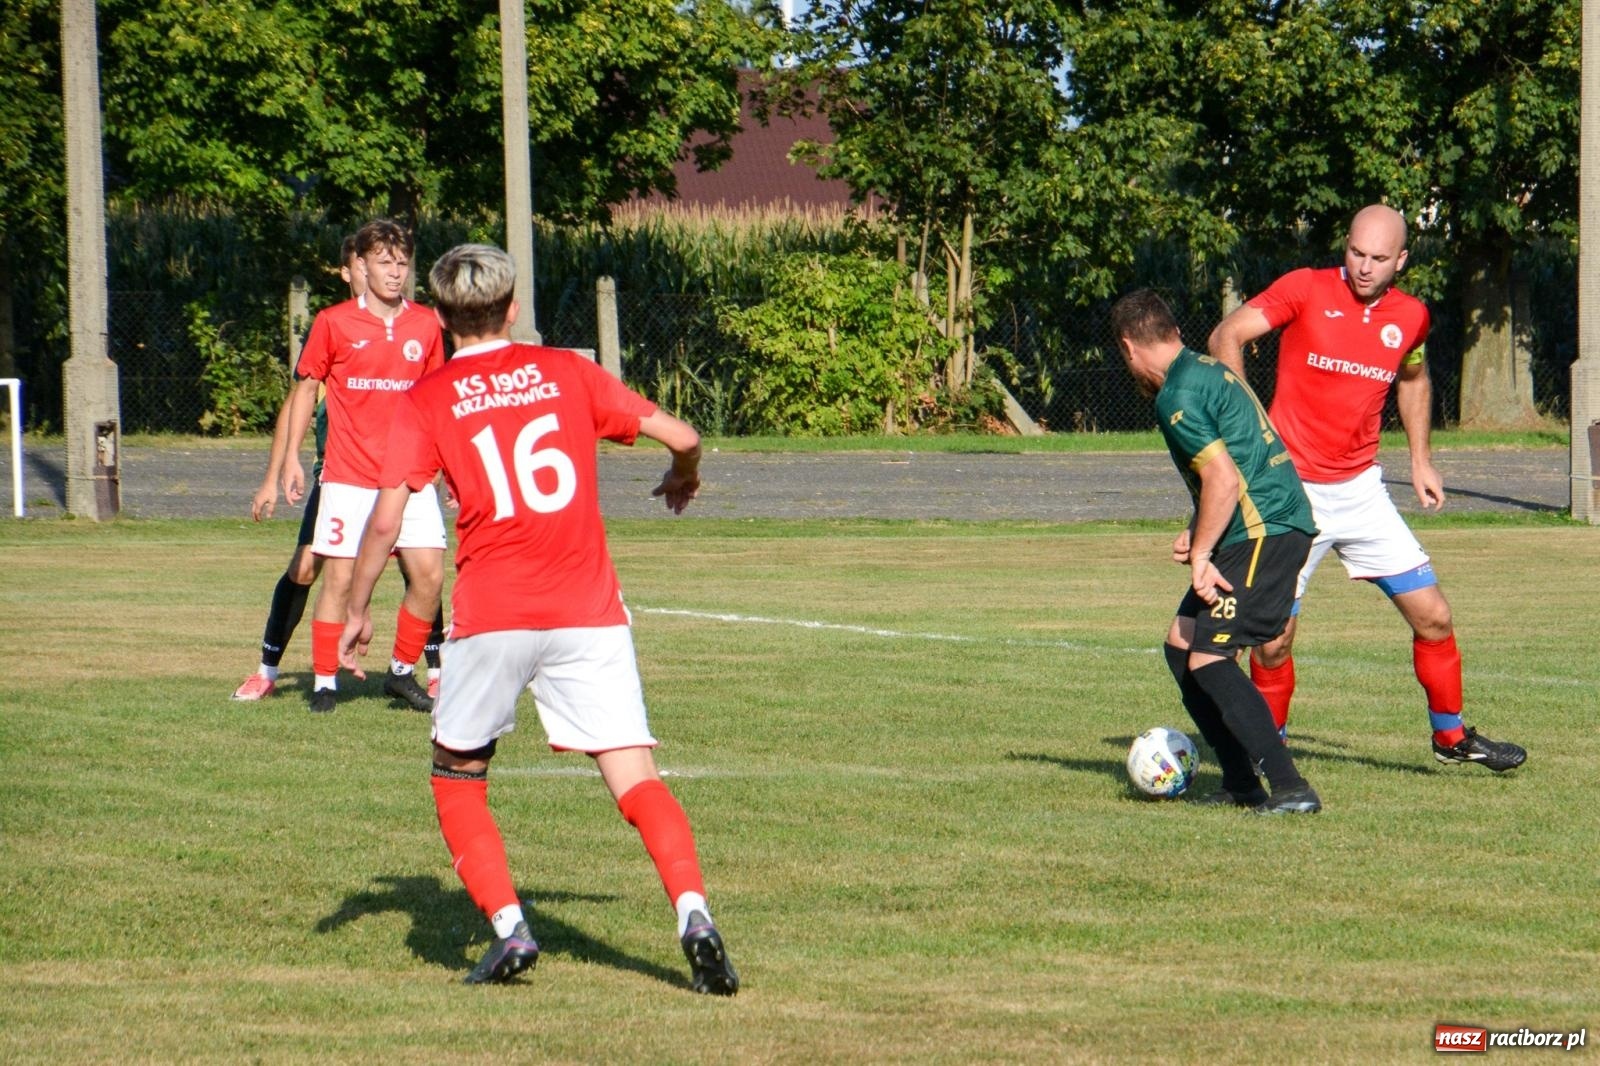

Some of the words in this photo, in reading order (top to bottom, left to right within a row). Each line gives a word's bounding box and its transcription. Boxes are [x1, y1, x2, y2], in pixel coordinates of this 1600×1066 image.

[452, 374, 487, 399] KS
[489, 363, 542, 392] 1905
[451, 382, 560, 419] KRZANOWICE
[470, 413, 577, 522] 16
[328, 517, 344, 545] 3
[1210, 596, 1237, 619] 26
